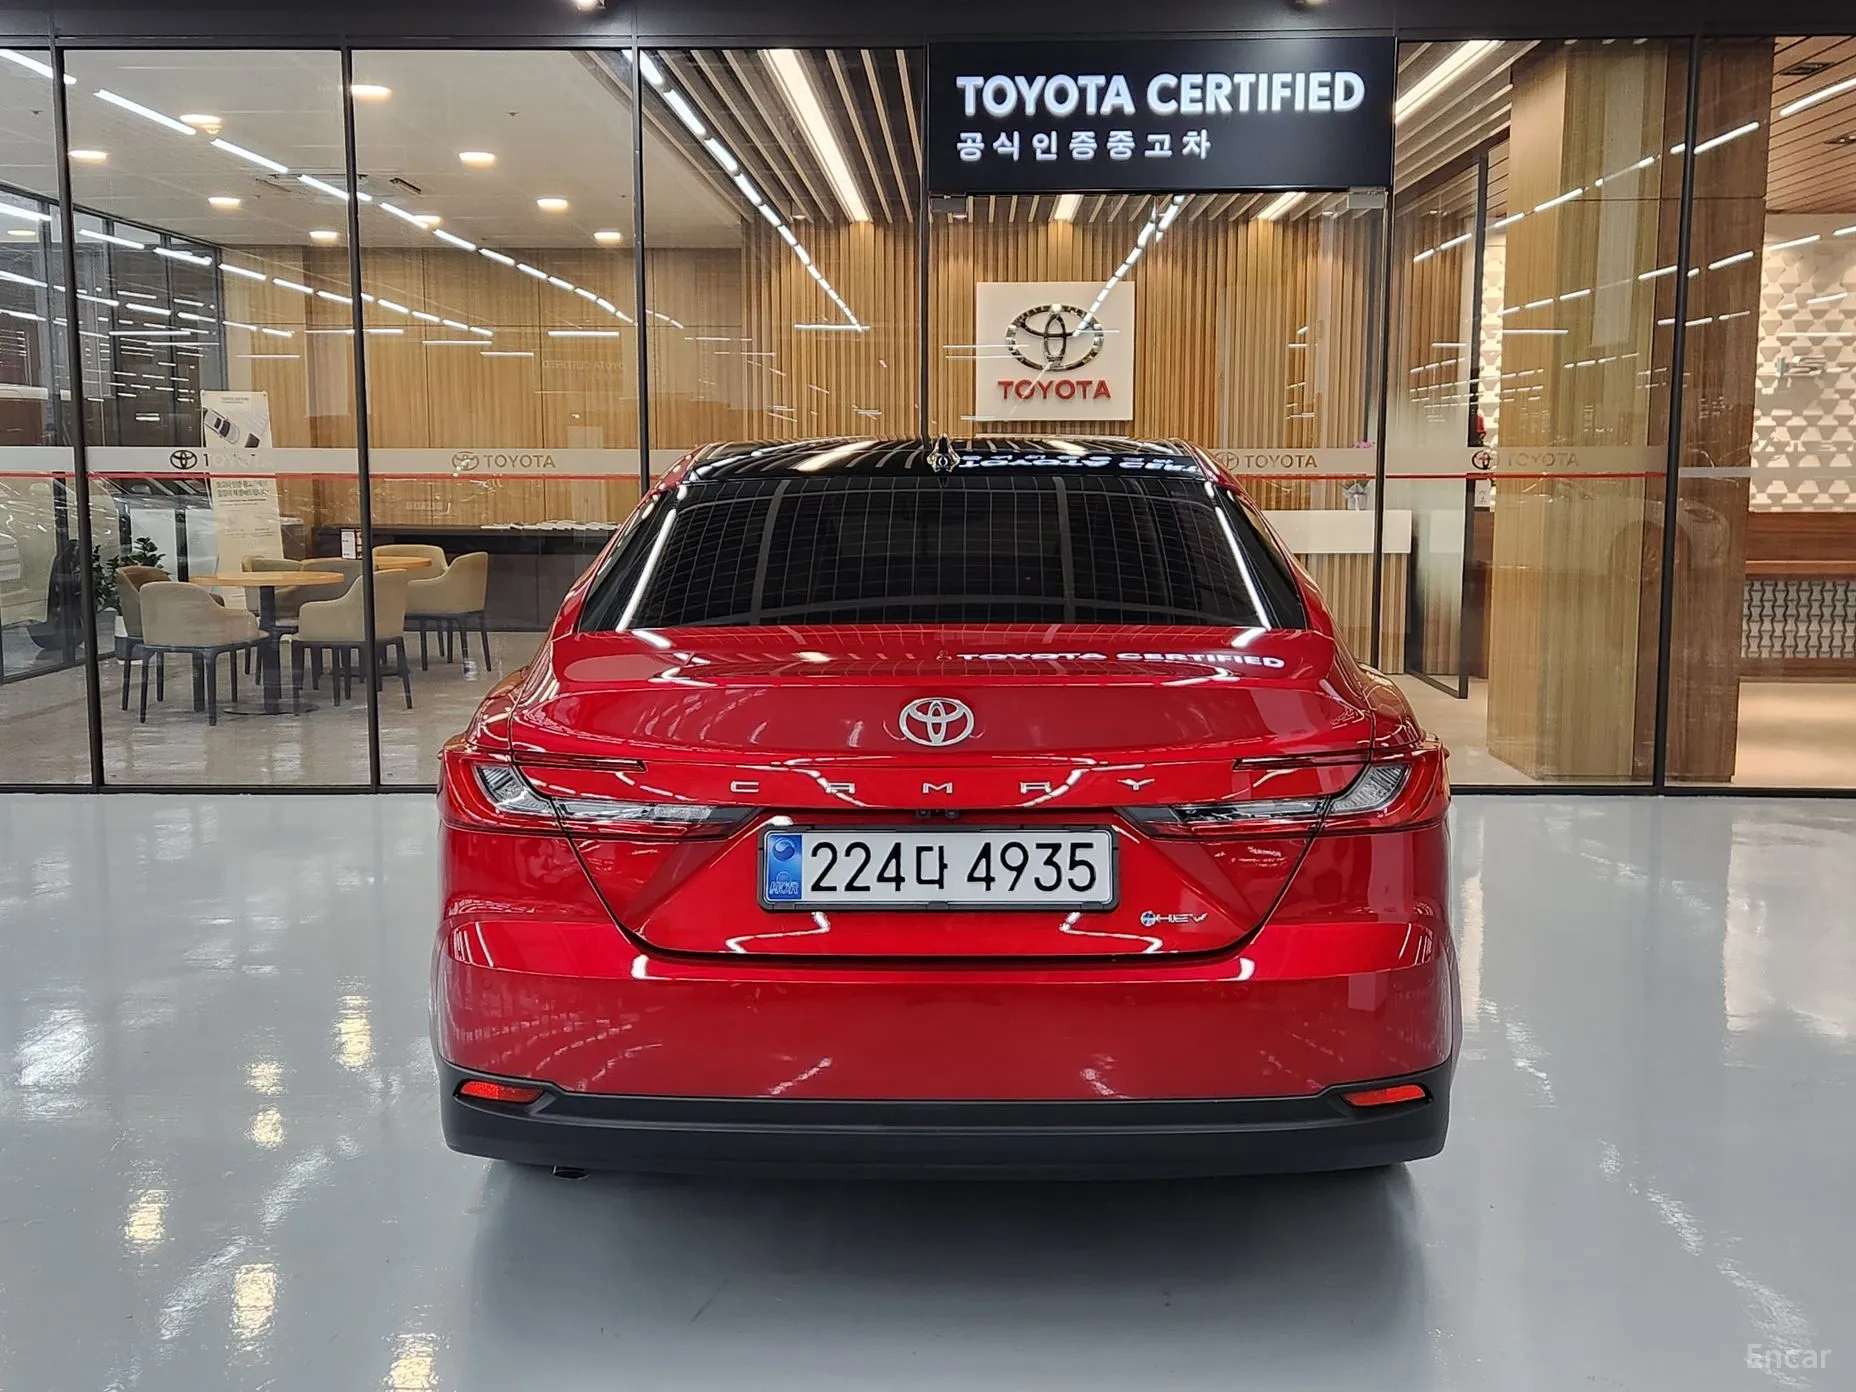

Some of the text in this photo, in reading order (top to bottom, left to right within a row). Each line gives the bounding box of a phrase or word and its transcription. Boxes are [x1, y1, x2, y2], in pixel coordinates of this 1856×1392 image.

[956, 71, 1366, 117] TOYOTA CERTIFIED
[956, 129, 1211, 161] 공식인증중고차
[997, 379, 1112, 400] TOYOTA
[483, 454, 556, 469] TOYOTA
[1244, 454, 1318, 469] TOYOTA
[1507, 452, 1580, 467] TOYOTA
[730, 778, 1156, 795] CAMRY
[811, 841, 1097, 892] 224다 4935
[769, 880, 800, 895] KOR
[1155, 912, 1209, 923] HEV
